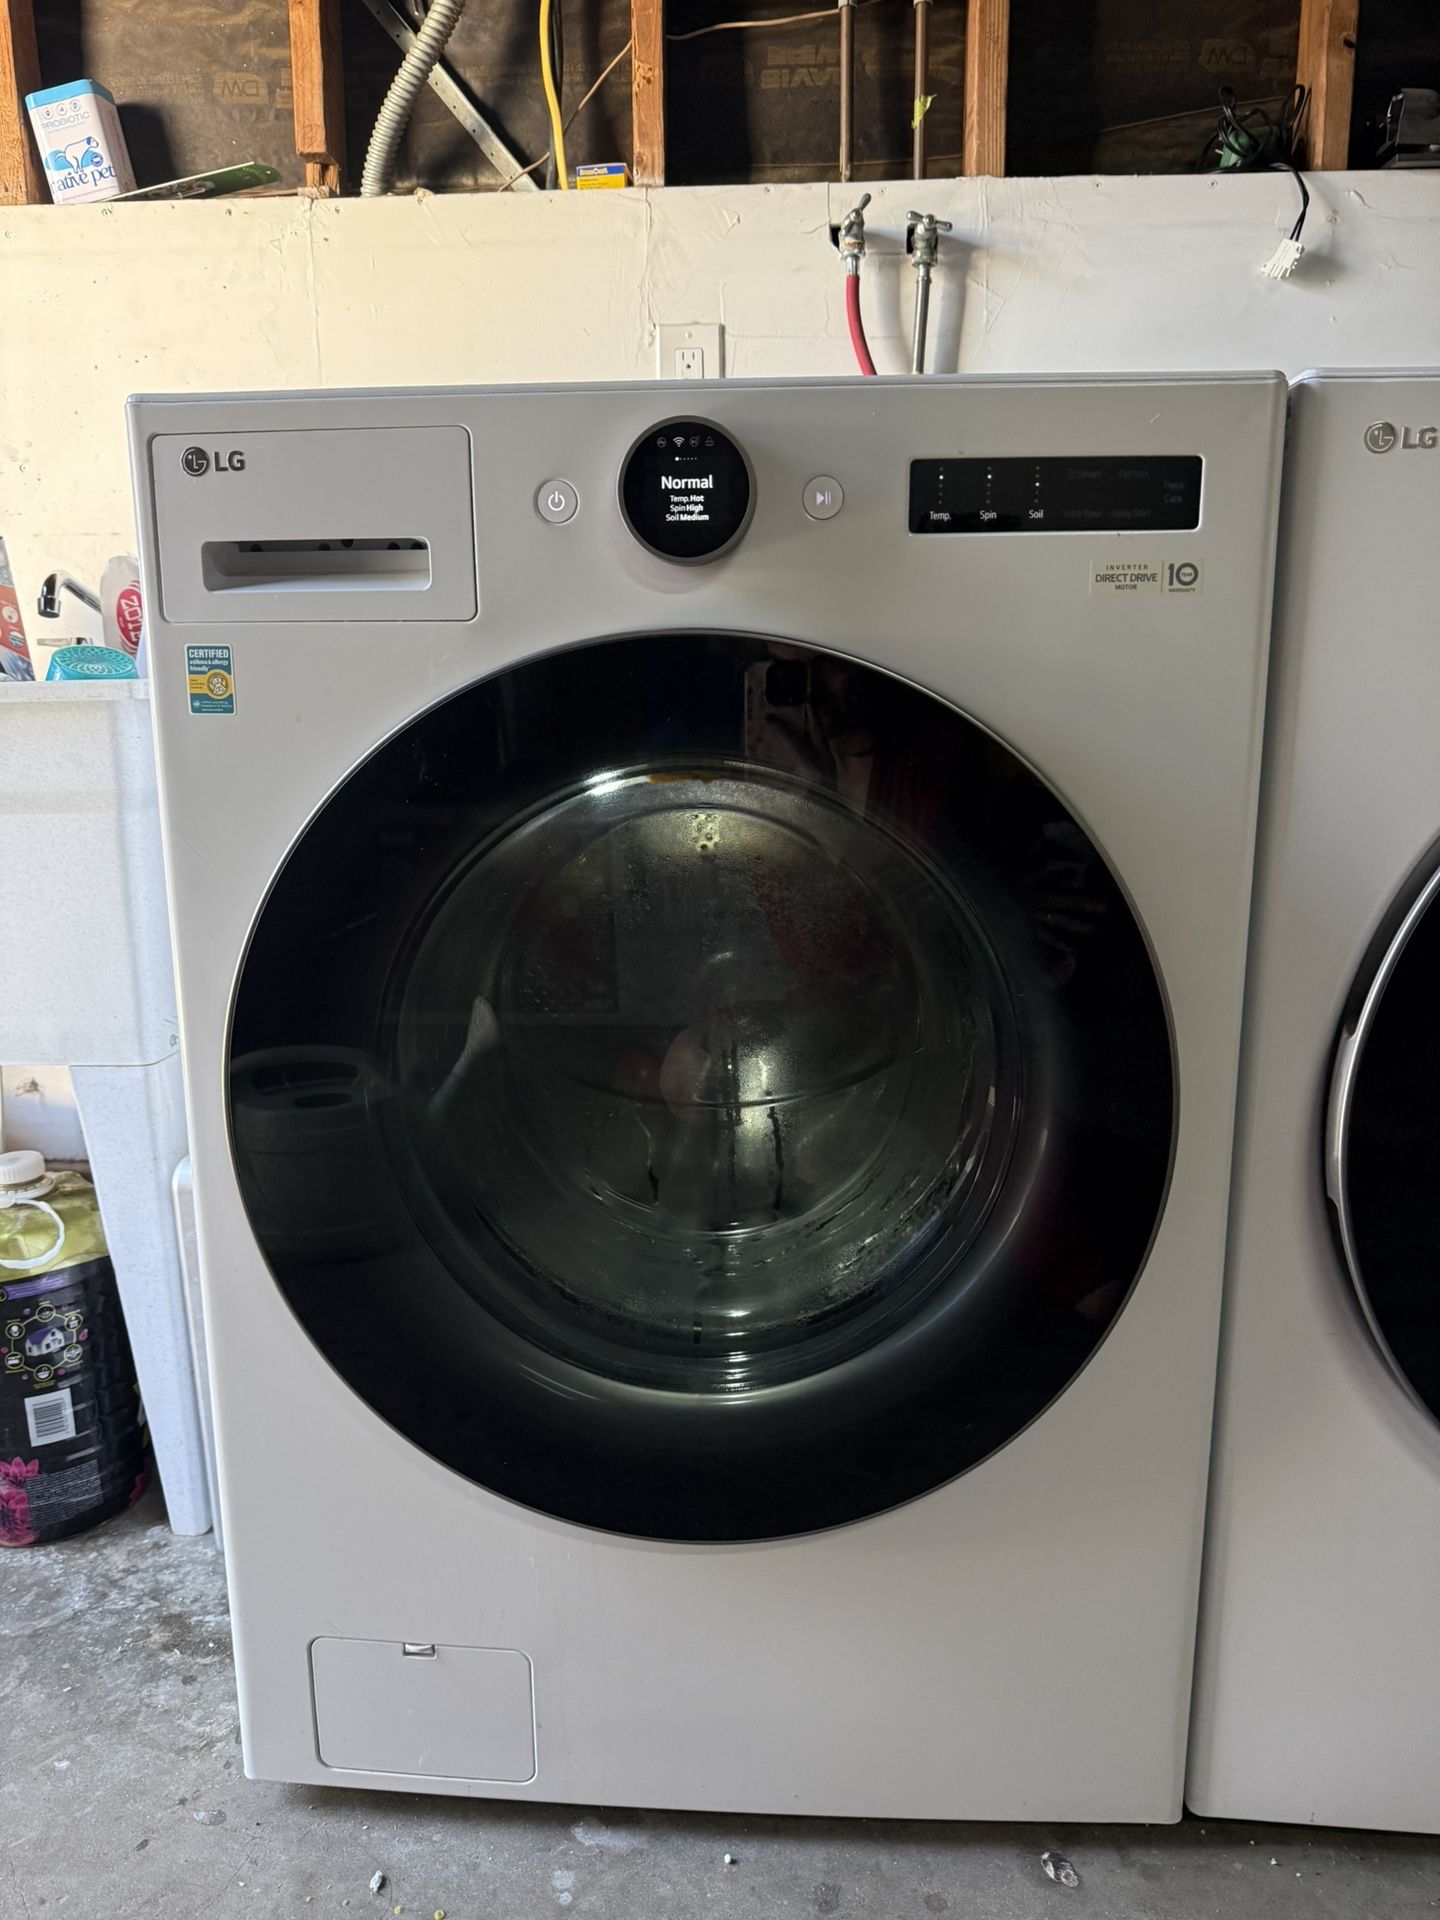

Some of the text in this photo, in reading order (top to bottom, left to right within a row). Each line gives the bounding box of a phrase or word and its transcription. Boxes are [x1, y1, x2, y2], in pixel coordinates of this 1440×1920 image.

[41, 111, 90, 129] PROBIOTIC
[91, 164, 117, 187] pet
[1401, 426, 1438, 449] LG
[213, 450, 246, 472] LG
[661, 474, 713, 490] Normal
[690, 494, 705, 503] Hot
[670, 504, 704, 514] Spin High
[1028, 509, 1044, 519] Soil
[665, 512, 710, 521] Soil Medium
[929, 511, 952, 522] Temp.
[980, 510, 997, 522] Spin
[1095, 573, 1158, 582] DIRECT DRIVE
[1168, 562, 1199, 587] 10
[189, 649, 229, 658] CERTIFIED
